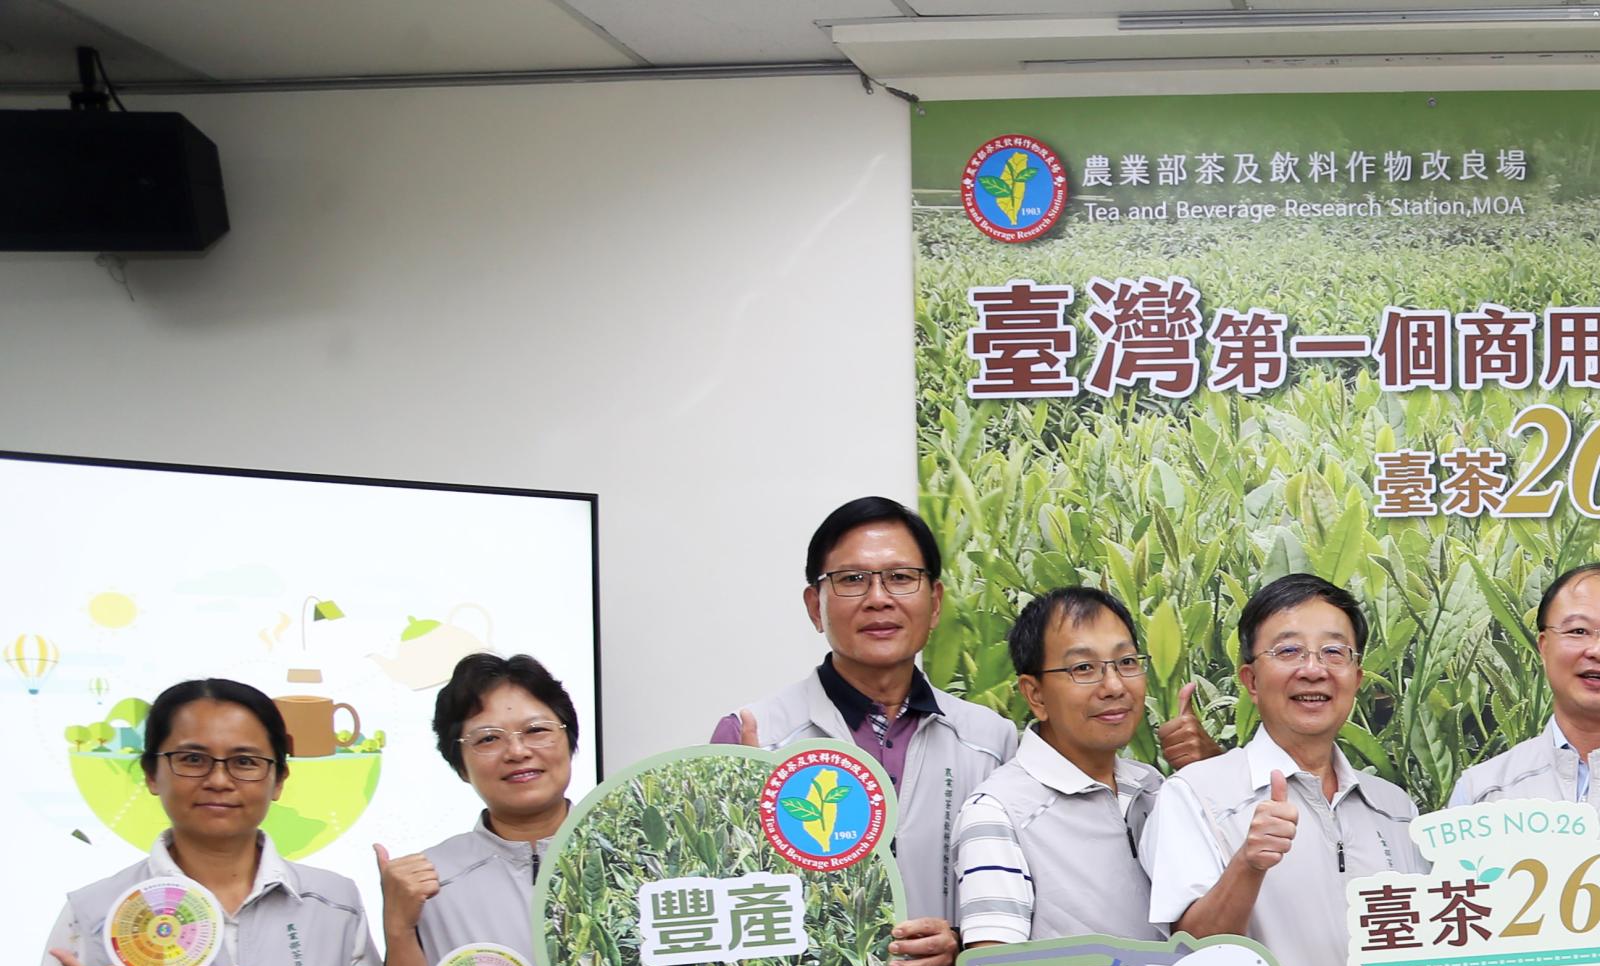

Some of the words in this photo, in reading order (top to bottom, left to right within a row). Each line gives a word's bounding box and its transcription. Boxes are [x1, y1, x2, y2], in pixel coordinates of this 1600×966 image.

[1082, 150, 1528, 187] 農業部茶及飲料作物改良場
[1084, 203, 1120, 221] Tea
[1128, 201, 1168, 219] and
[1176, 200, 1275, 223] Beverage
[1286, 199, 1382, 217] Research
[1390, 196, 1525, 218] Station,MOA
[834, 831, 857, 840] 1903
[1422, 815, 1493, 849] TBRS
[1504, 811, 1586, 836] NO.26
[786, 847, 829, 869] Beverage
[831, 840, 870, 865] Research
[651, 883, 797, 955] 豐產
